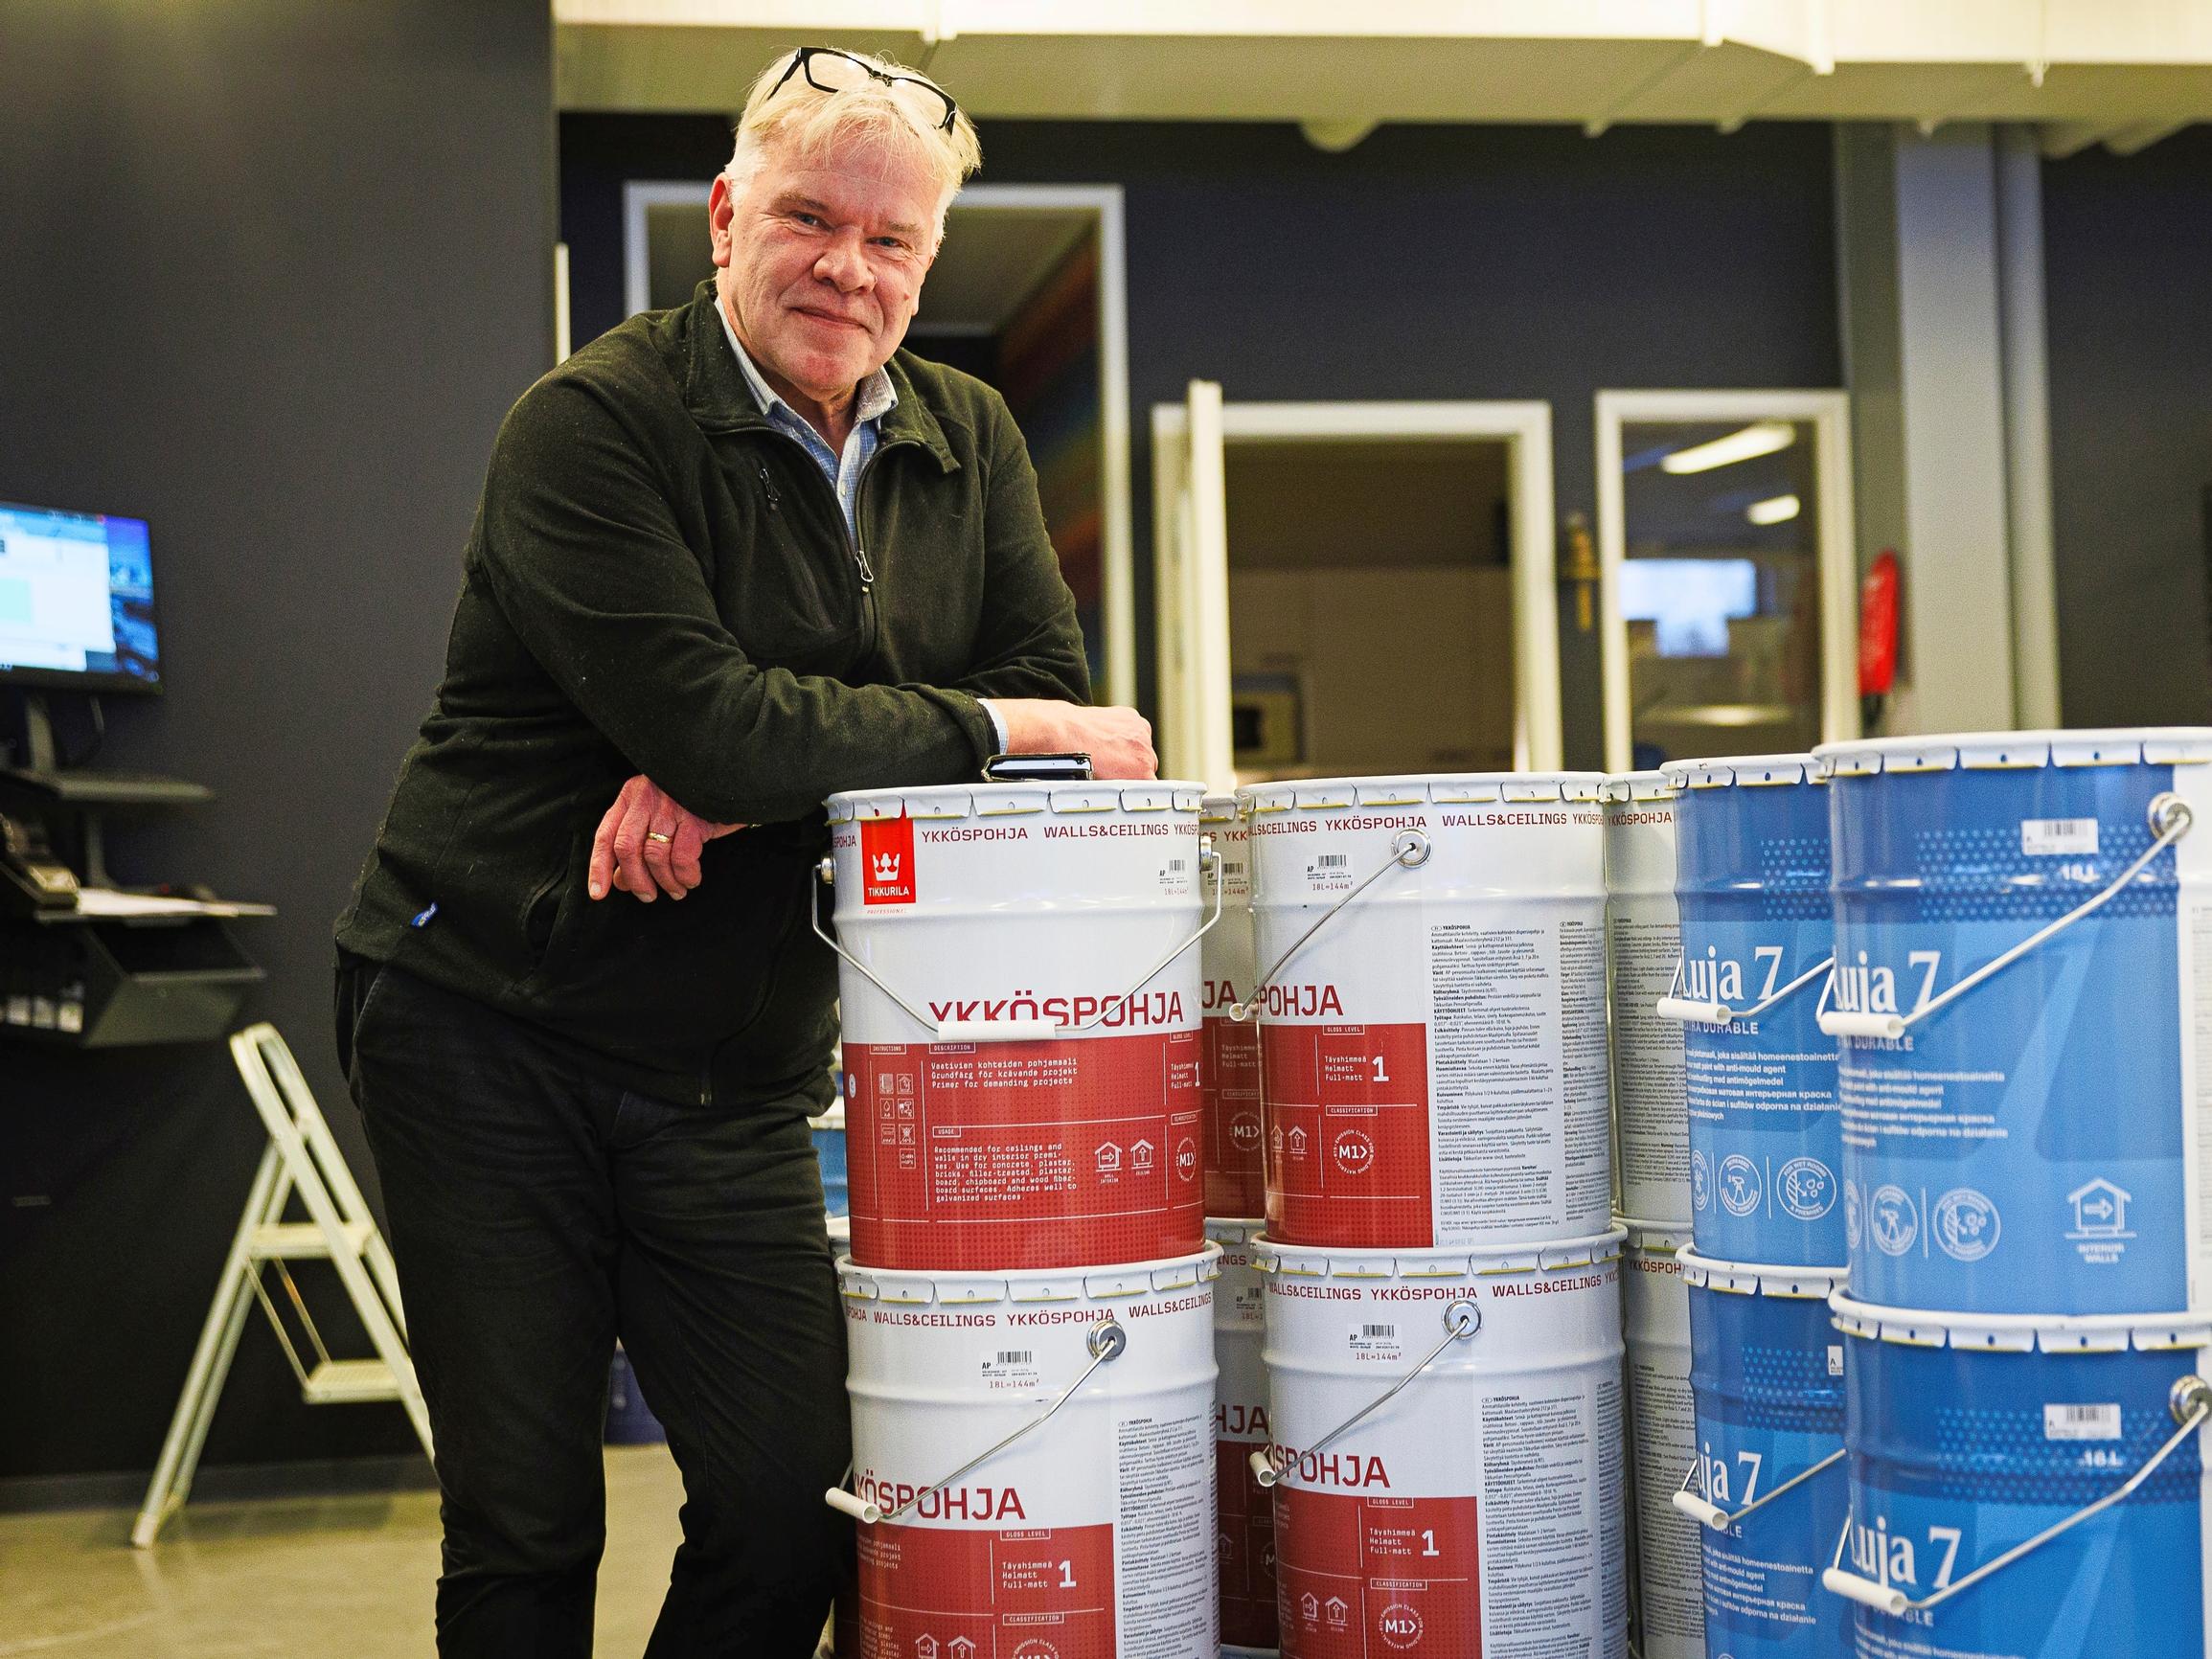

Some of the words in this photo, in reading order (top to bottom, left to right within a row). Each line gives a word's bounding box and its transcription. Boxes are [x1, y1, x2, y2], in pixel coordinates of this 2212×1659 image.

[1325, 815, 1426, 831] YKKÖSPOHJA
[1442, 813, 1567, 827] WALLS&CEILINGS
[1608, 811, 1673, 827] YKKÖSPOHJA
[922, 827, 1029, 843] YKKÖSPOHJA
[1043, 824, 1169, 839] WALLS&CEILINGS
[868, 886, 910, 898] TIKKURILA
[1754, 945, 1784, 1001] 7
[1908, 949, 1941, 1012] 7
[928, 989, 1184, 1029] YKKÖSPOHJA
[978, 1060, 1022, 1069] kohteiden
[1028, 1057, 1077, 1067] pohjamaali
[1325, 1055, 1367, 1064] Täyshimmeä
[931, 1070, 973, 1079] Grundfärg
[978, 1070, 992, 1079] för
[998, 1069, 1038, 1078] krävande
[1043, 1067, 1078, 1077] projekt
[1372, 1057, 1389, 1082] 1
[1763, 1065, 1786, 1075] agent
[983, 1079, 1028, 1089] demanding
[1033, 1077, 1073, 1086] projects
[1799, 1091, 1832, 1100] краска
[1756, 1102, 1789, 1111] odporna
[1005, 1144, 1042, 1153] ceilings
[973, 1153, 987, 1162] dry
[966, 1177, 1007, 1187] chipboard
[936, 1194, 980, 1203] galvanized
[1371, 1285, 1477, 1302] YKKÖSPOHJA
[1493, 1275, 1602, 1298] WALLS&CEILINGS
[874, 1311, 995, 1327] WALLS&CEILINGS
[1007, 1308, 1114, 1327] YKKÖSPOHJA
[1129, 1291, 1212, 1318] WALLS&CEILINGS
[1738, 1450, 1763, 1506] 7
[1369, 1528, 1416, 1537] Täyshimmeä
[1421, 1530, 1440, 1557] 1
[1927, 1525, 1962, 1590] 7
[1002, 1560, 1053, 1571] Täyshimmeä
[1002, 1571, 1038, 1579] Helmatt
[1058, 1559, 1077, 1588] 1
[1745, 1571, 1765, 1581] agent
[1003, 1580, 1048, 1589] Full-matt
[1776, 1601, 1806, 1611] краска
[1768, 1612, 1779, 1621] na
